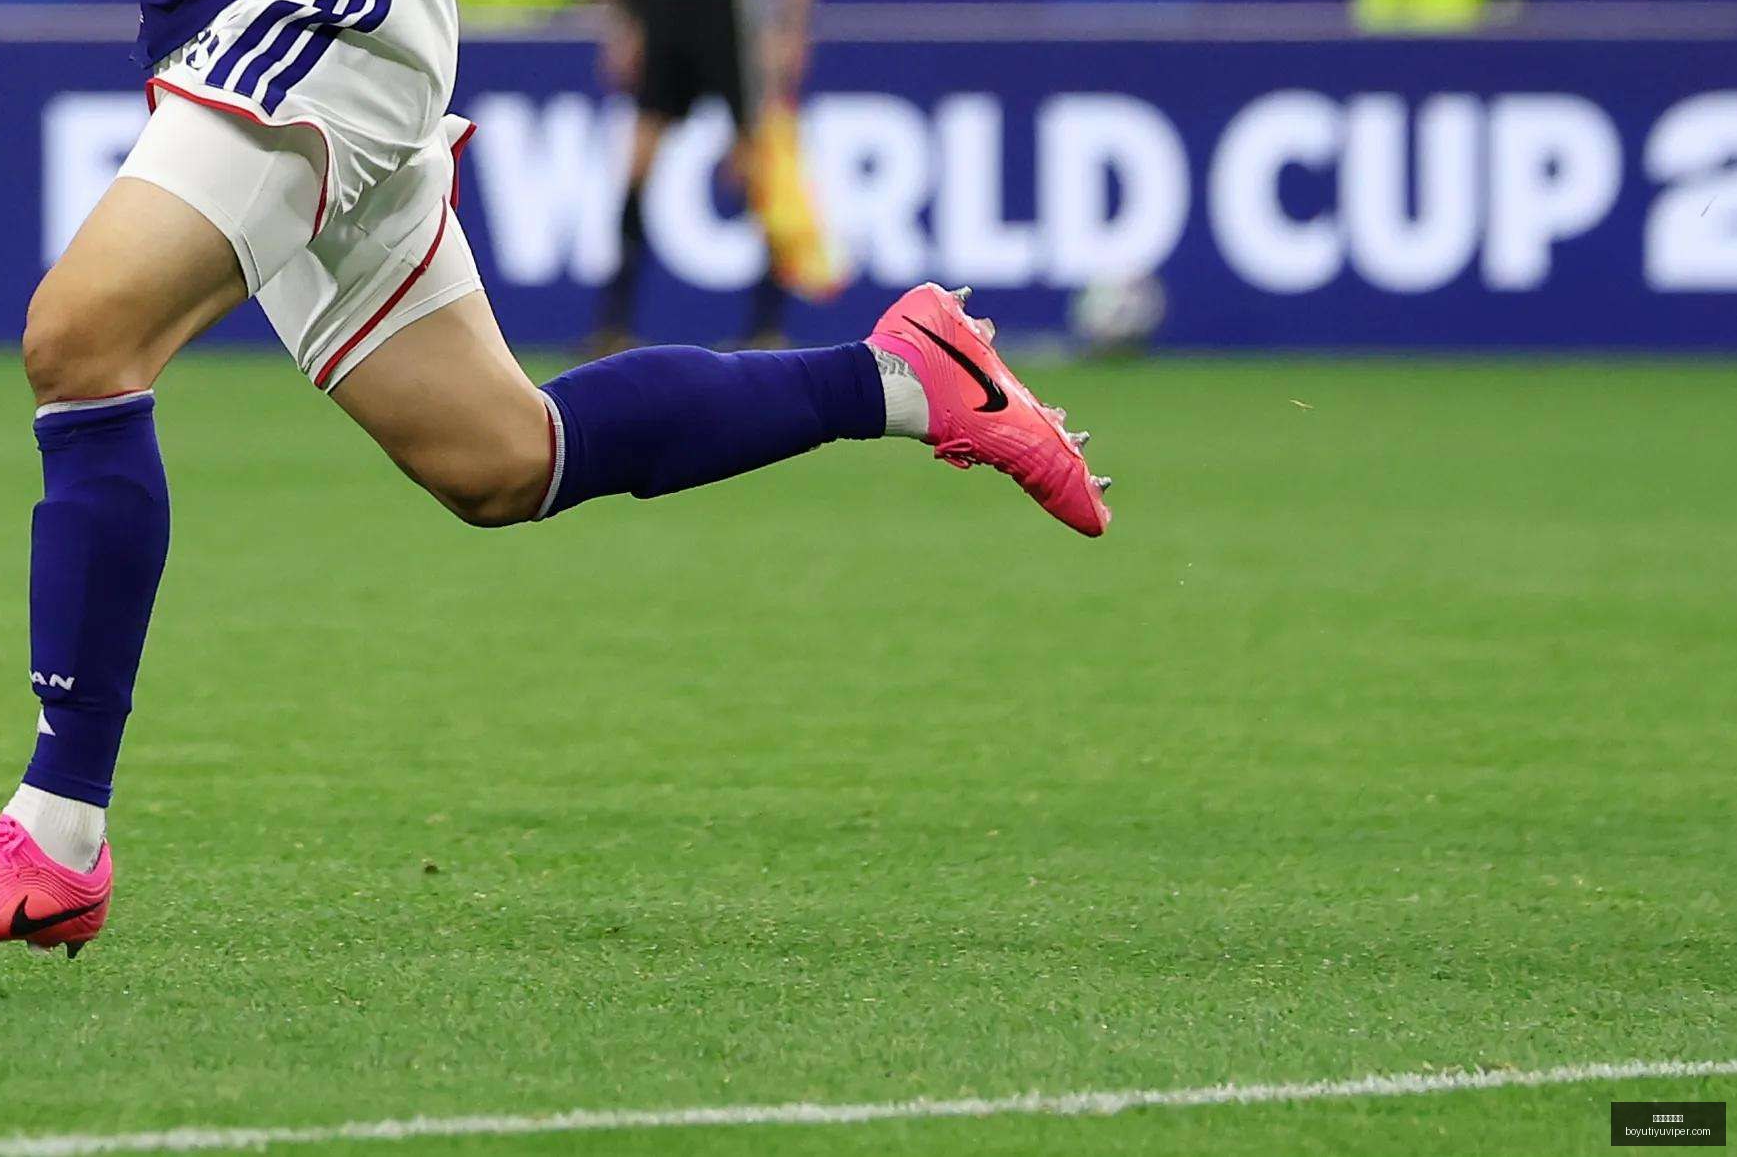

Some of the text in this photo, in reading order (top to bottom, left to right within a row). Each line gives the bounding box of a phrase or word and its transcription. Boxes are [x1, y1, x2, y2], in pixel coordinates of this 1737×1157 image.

[466, 88, 1737, 294] WORLD CUP 2
[29, 669, 75, 691] AN
